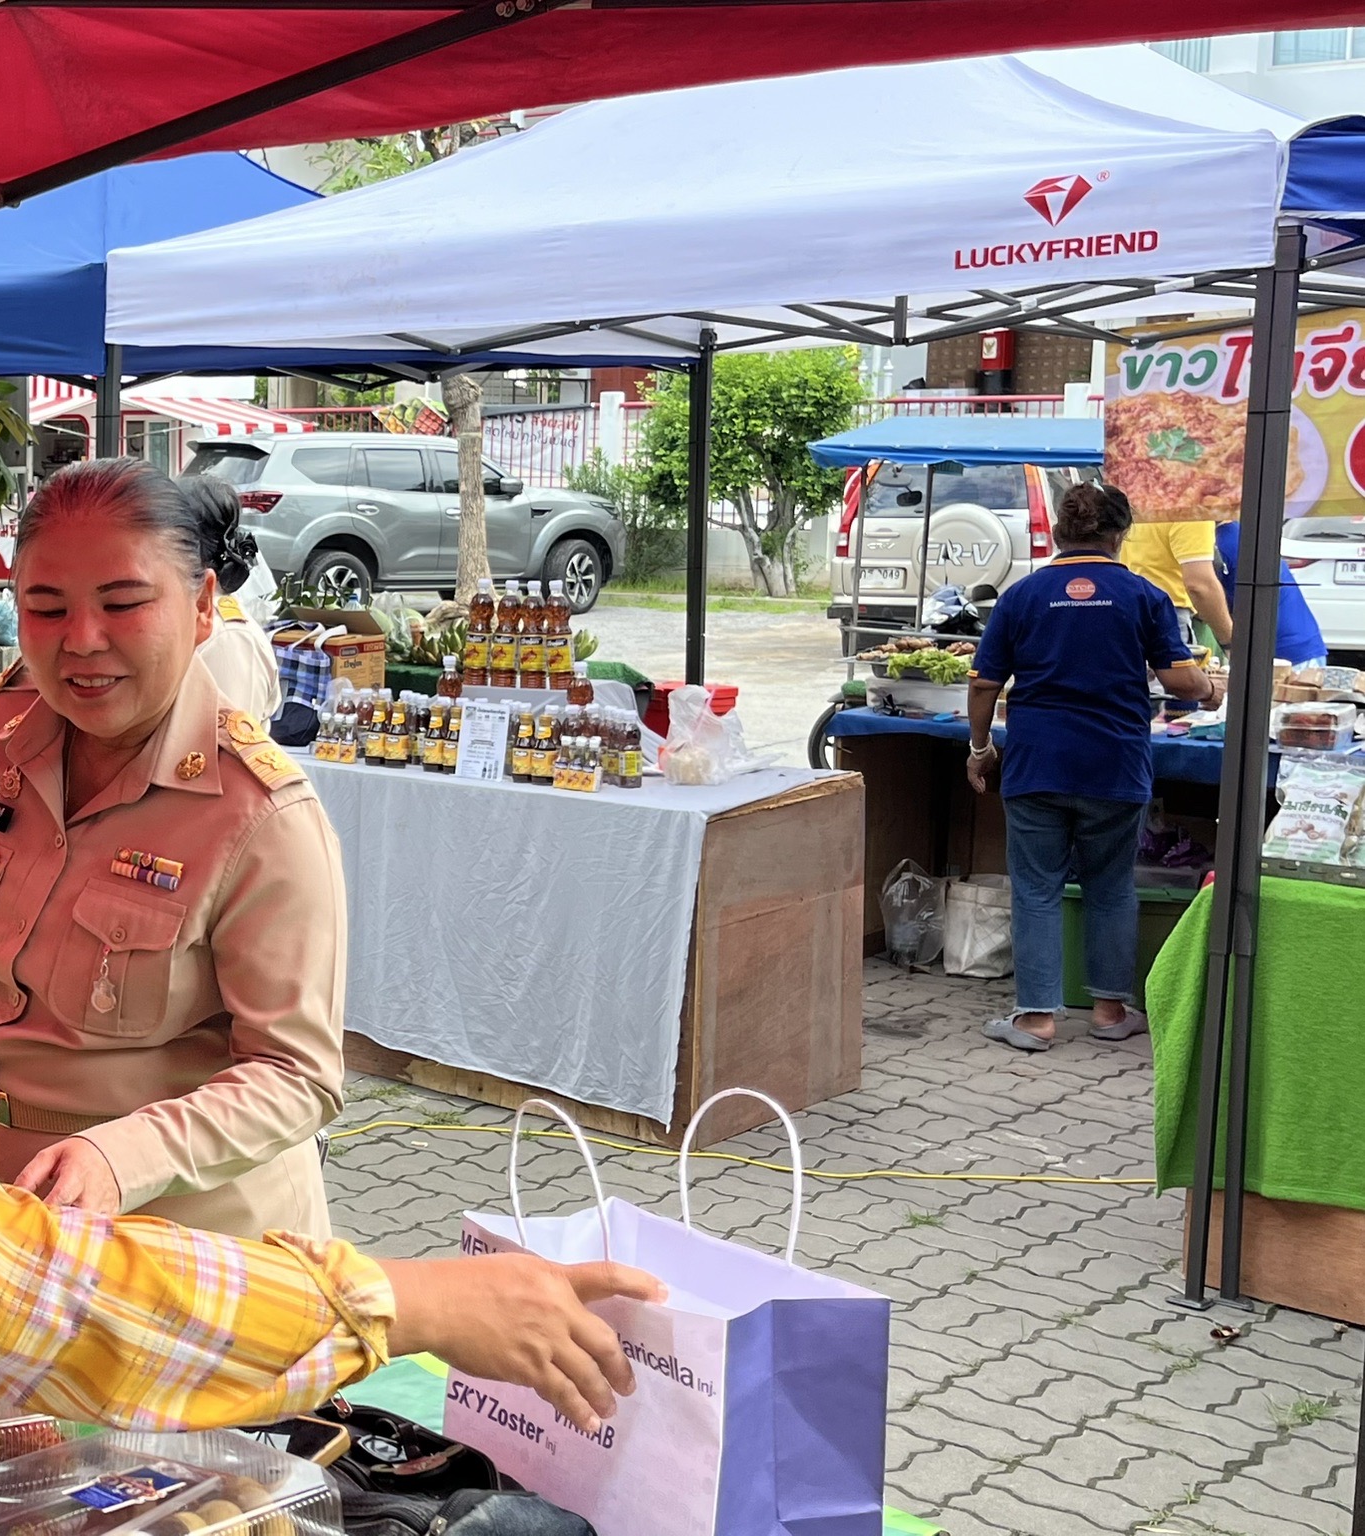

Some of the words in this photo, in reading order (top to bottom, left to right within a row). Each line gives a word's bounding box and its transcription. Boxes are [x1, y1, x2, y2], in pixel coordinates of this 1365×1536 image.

[954, 230, 1159, 270] LUCKYFRIEND
[866, 542, 896, 550] CR-V
[917, 542, 1000, 567] CR-V
[616, 1332, 695, 1390] aricella
[446, 1380, 545, 1444] SKYZoster
